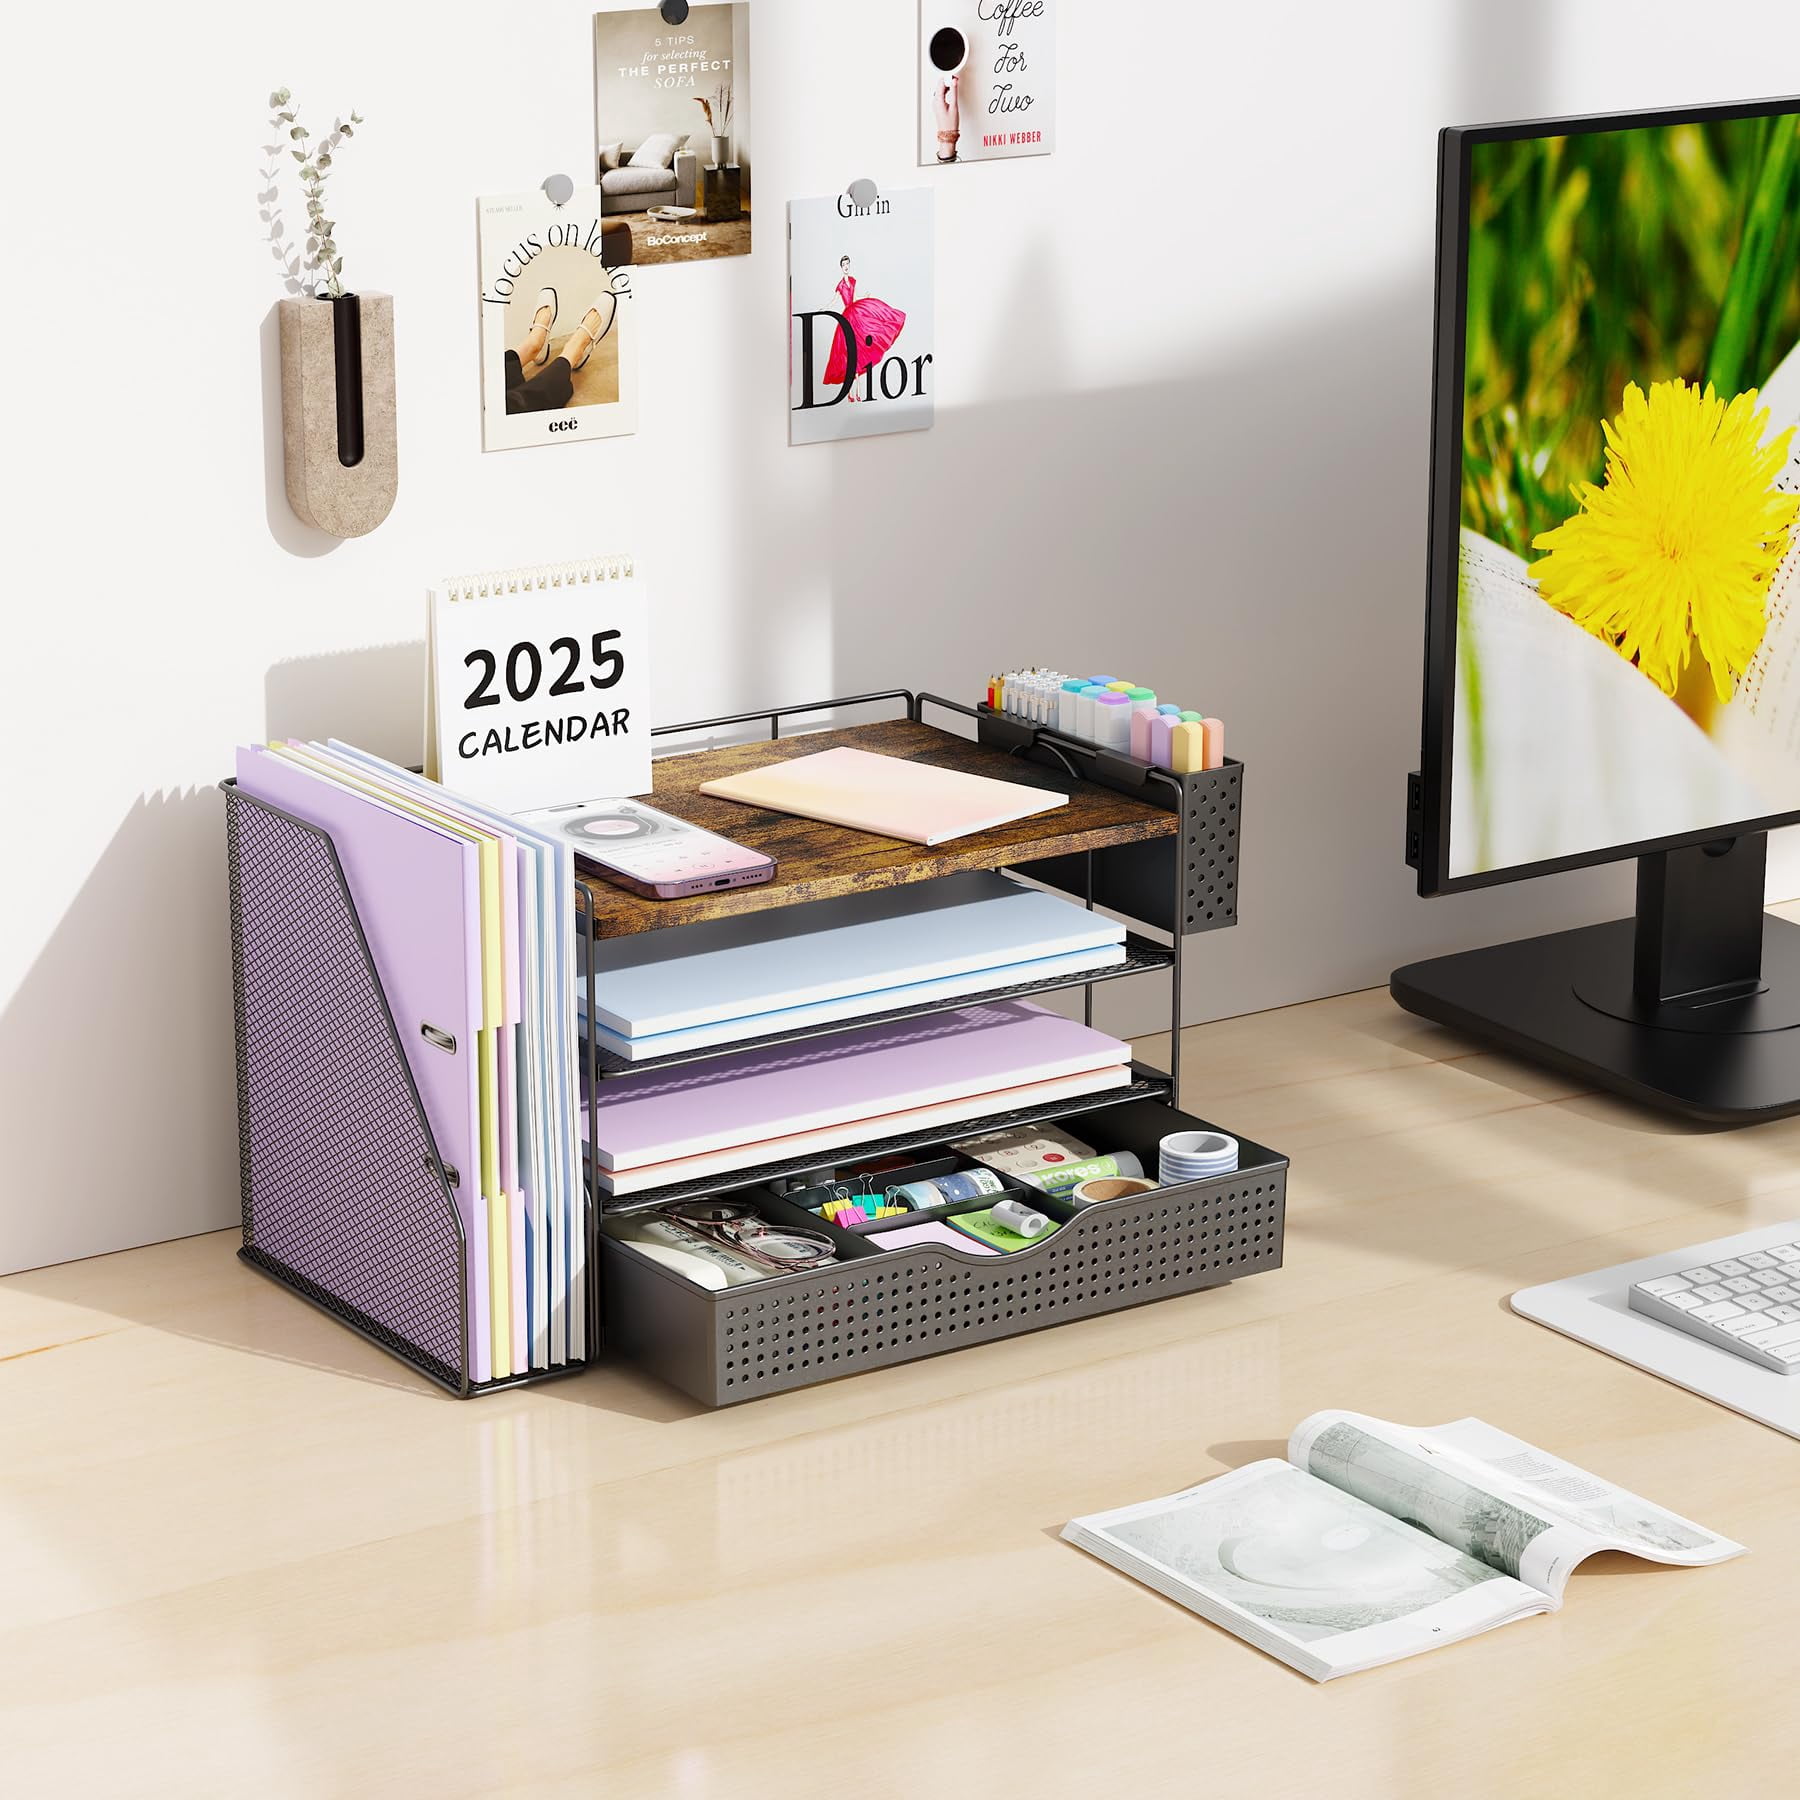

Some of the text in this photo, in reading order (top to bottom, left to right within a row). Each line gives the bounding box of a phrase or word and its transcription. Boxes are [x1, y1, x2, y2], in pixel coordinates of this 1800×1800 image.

[655, 35, 695, 47] 5 TIPS
[641, 49, 708, 65] for selecting
[994, 43, 1028, 74] For
[618, 59, 732, 78] THE PERFECT
[653, 75, 696, 89] SOFA
[988, 84, 1035, 114] Two
[983, 131, 1042, 147] NIKKI WEBBER
[876, 195, 891, 215] in
[548, 223, 579, 248] on
[647, 231, 708, 247] BoConcept
[792, 310, 933, 411] Dior
[463, 629, 625, 710] 2025
[458, 708, 631, 759] CALENDAR
